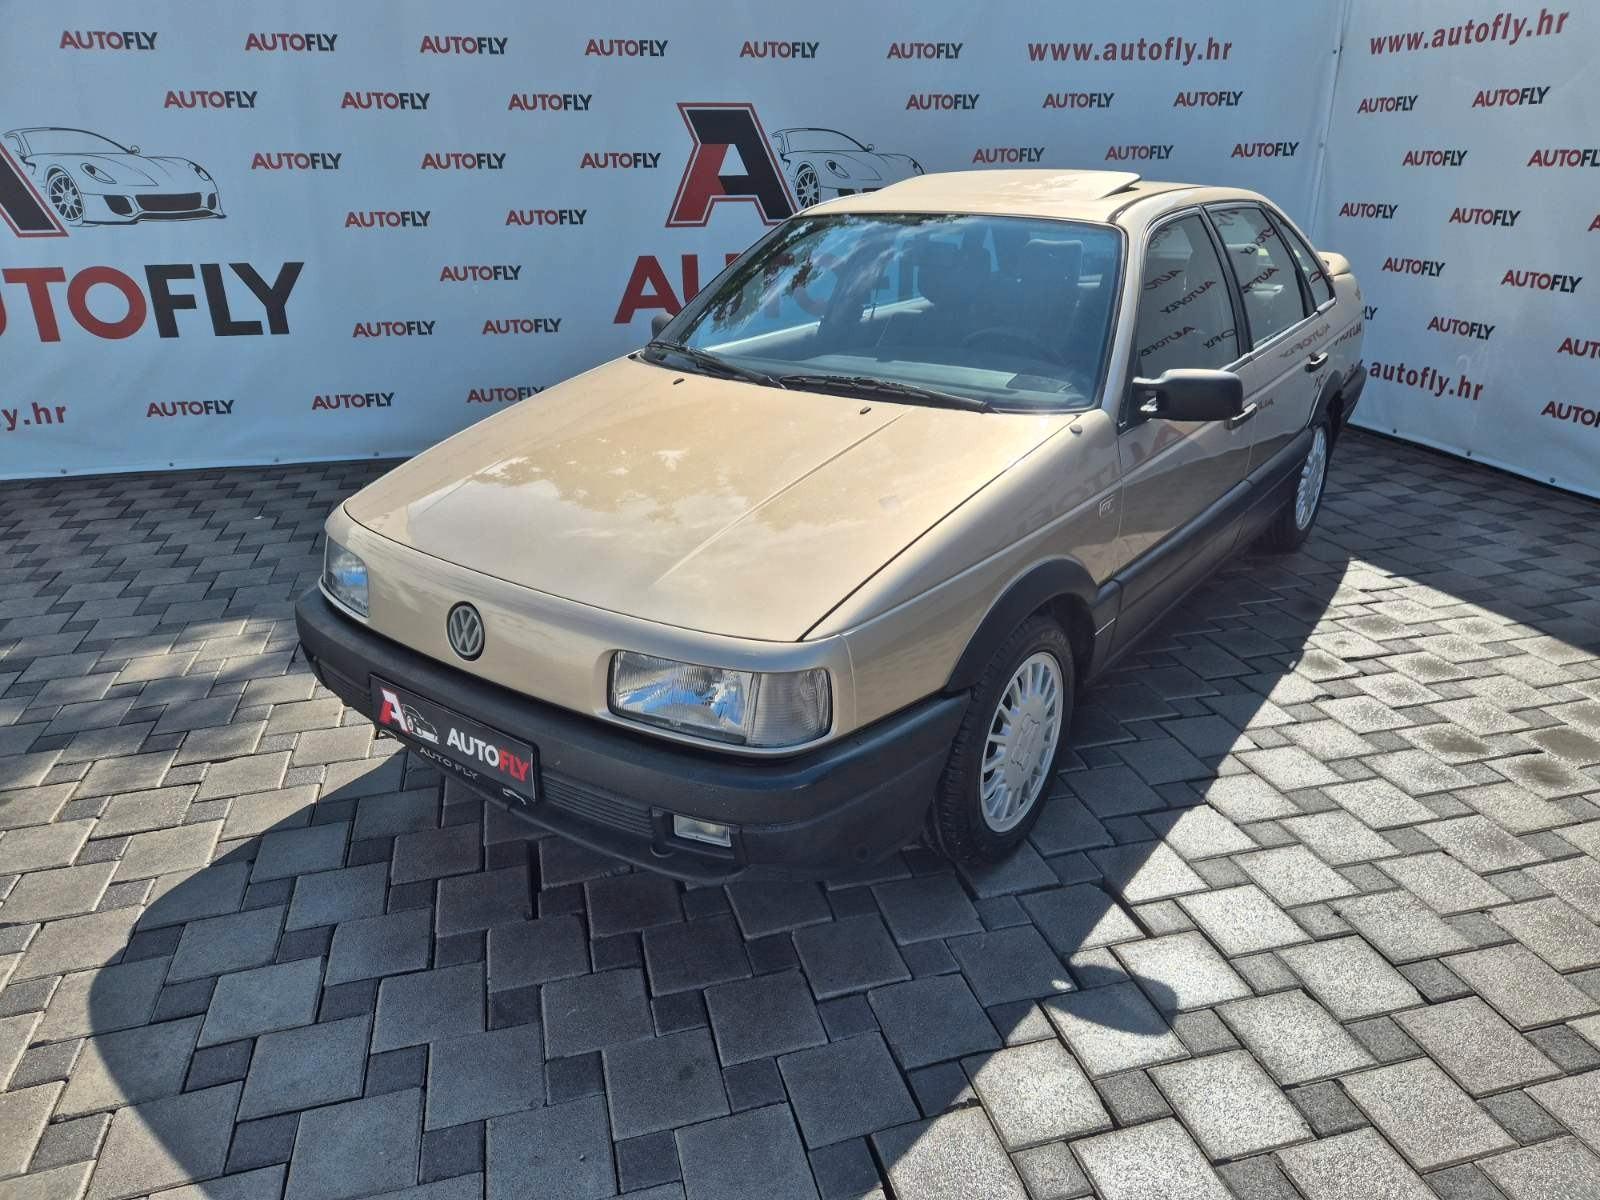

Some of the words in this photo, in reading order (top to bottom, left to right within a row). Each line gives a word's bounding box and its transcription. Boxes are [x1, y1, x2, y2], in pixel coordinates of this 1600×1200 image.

[60, 31, 158, 50] AUTOFLY
[1370, 8, 1569, 55] www.autofly.hr
[245, 33, 337, 51] AUTOFLY
[420, 36, 507, 54] AUTOFLY
[585, 39, 668, 57] AUTOFLY
[739, 41, 820, 58] AUTOFLY
[887, 43, 963, 59] AUTOFLY
[1028, 36, 1233, 65] www.autofly.hr
[164, 91, 258, 108] AUTOFLY
[341, 92, 430, 110] AUTOFLY
[508, 94, 592, 111] AUTOFLY
[906, 94, 980, 110] AUTOFLY
[1042, 92, 1115, 109] AUTOFLY
[1173, 91, 1243, 108] AUTOFLY
[1357, 95, 1418, 113] AUTOFLY
[1472, 86, 1550, 108] AUTOFLY
[972, 147, 1045, 164] AUTOFLY
[1104, 144, 1174, 162] AUTOFLY
[1231, 141, 1299, 159] AUTOFLY
[1402, 150, 1467, 166] AUTOFLY
[1527, 149, 1600, 167] AUTOFL
[251, 152, 341, 169] AUTOFLY
[421, 152, 506, 169] AUTOFLY
[580, 152, 661, 169] AUTOFLY
[345, 211, 430, 228] AUTOFLY
[505, 209, 587, 226] AUTOFLY
[1339, 202, 1398, 219] AUTOFLY
[1449, 207, 1521, 226] AUTOFLY
[440, 264, 522, 282] AUTOFLY
[1382, 257, 1445, 277] AUTOFLY
[1501, 270, 1583, 293] AUTOFLY
[0, 262, 304, 342] TOFLY
[352, 320, 436, 338] AUTOFLY
[482, 318, 562, 336] AUTOFLY
[1427, 316, 1496, 340] AUTOFLY
[1557, 337, 1600, 359] AUT
[1361, 359, 1484, 401] autofly.hr
[146, 399, 234, 418] AUTOFLY
[312, 392, 395, 411] AUTOFLY
[446, 727, 530, 782] AUTOFLY
